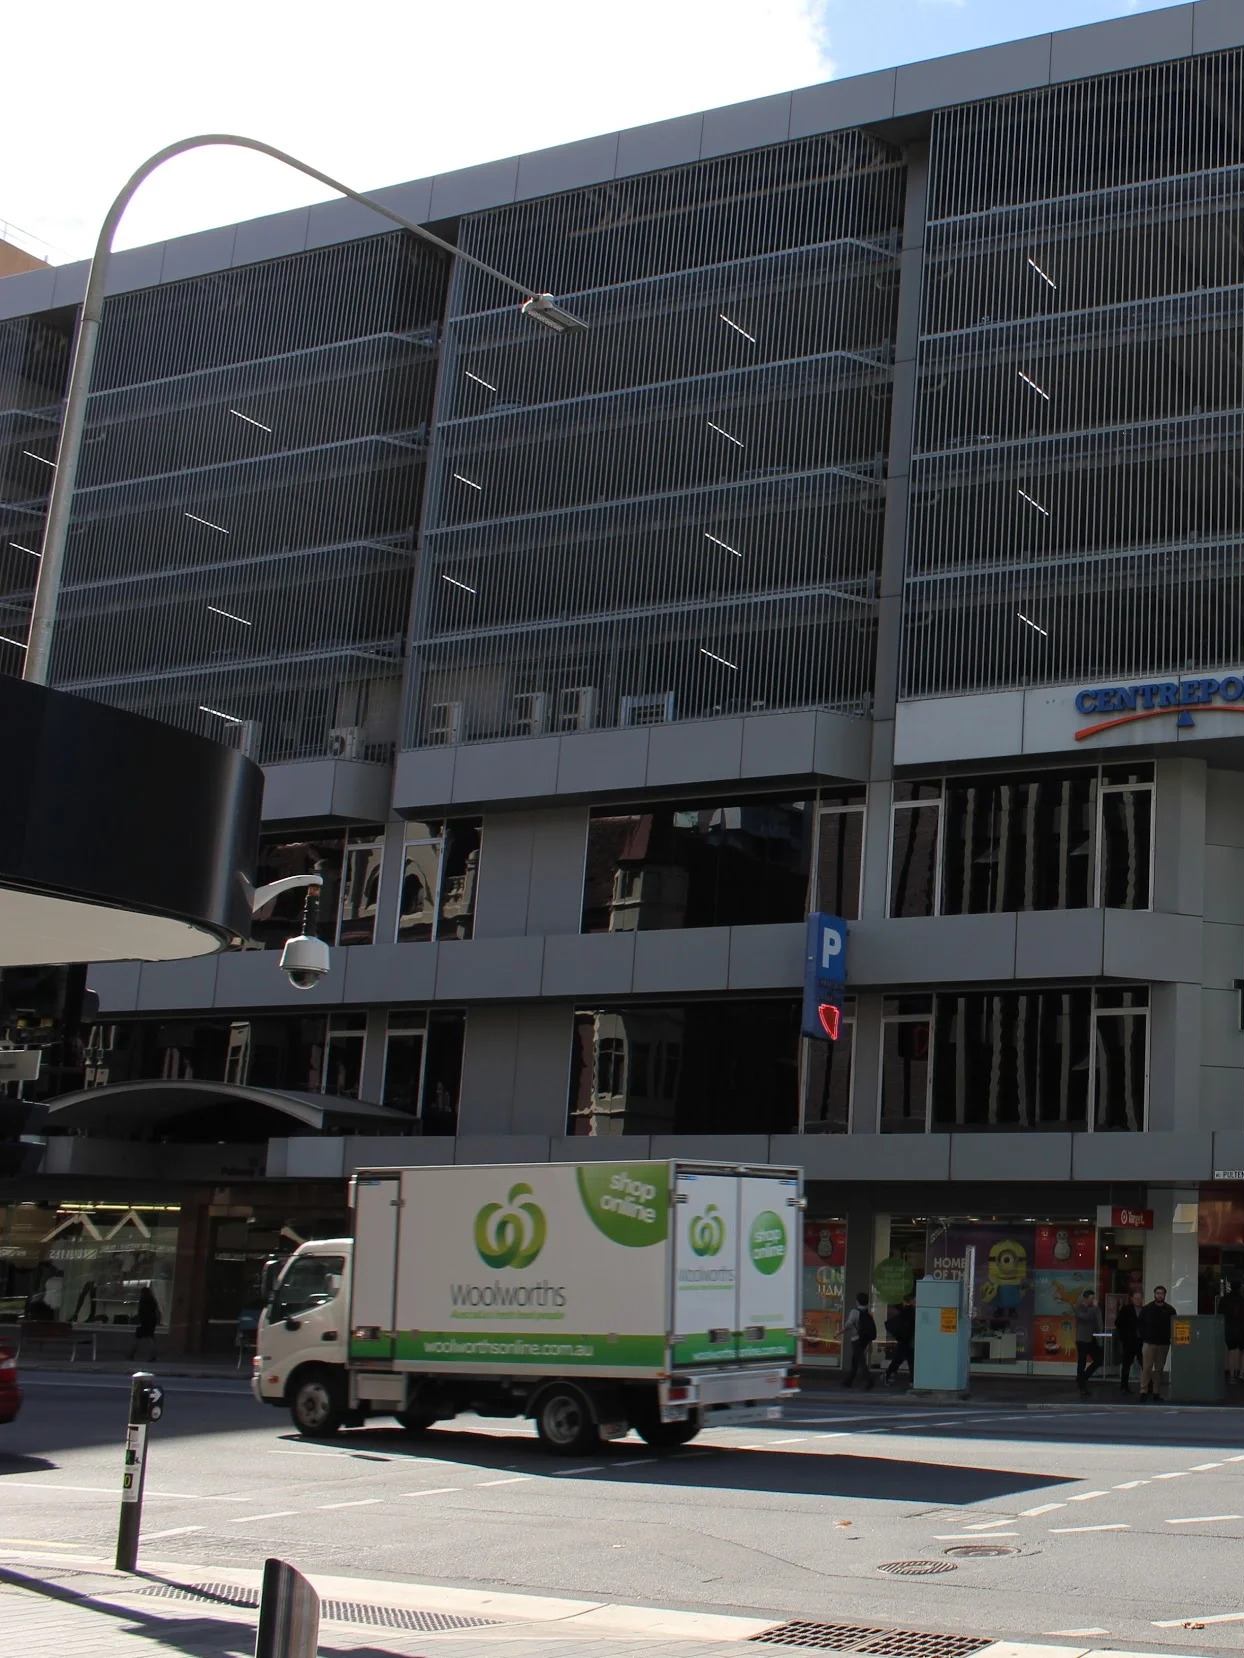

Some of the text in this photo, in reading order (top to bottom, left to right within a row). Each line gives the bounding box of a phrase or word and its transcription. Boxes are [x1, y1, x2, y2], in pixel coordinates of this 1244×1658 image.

[822, 927, 842, 969] P
[609, 1172, 656, 1200] shop
[600, 1195, 657, 1223] online
[933, 1269, 948, 1281] OF
[450, 1279, 567, 1307] Woolworths
[424, 1339, 595, 1357] woolworthsonline.com.au
